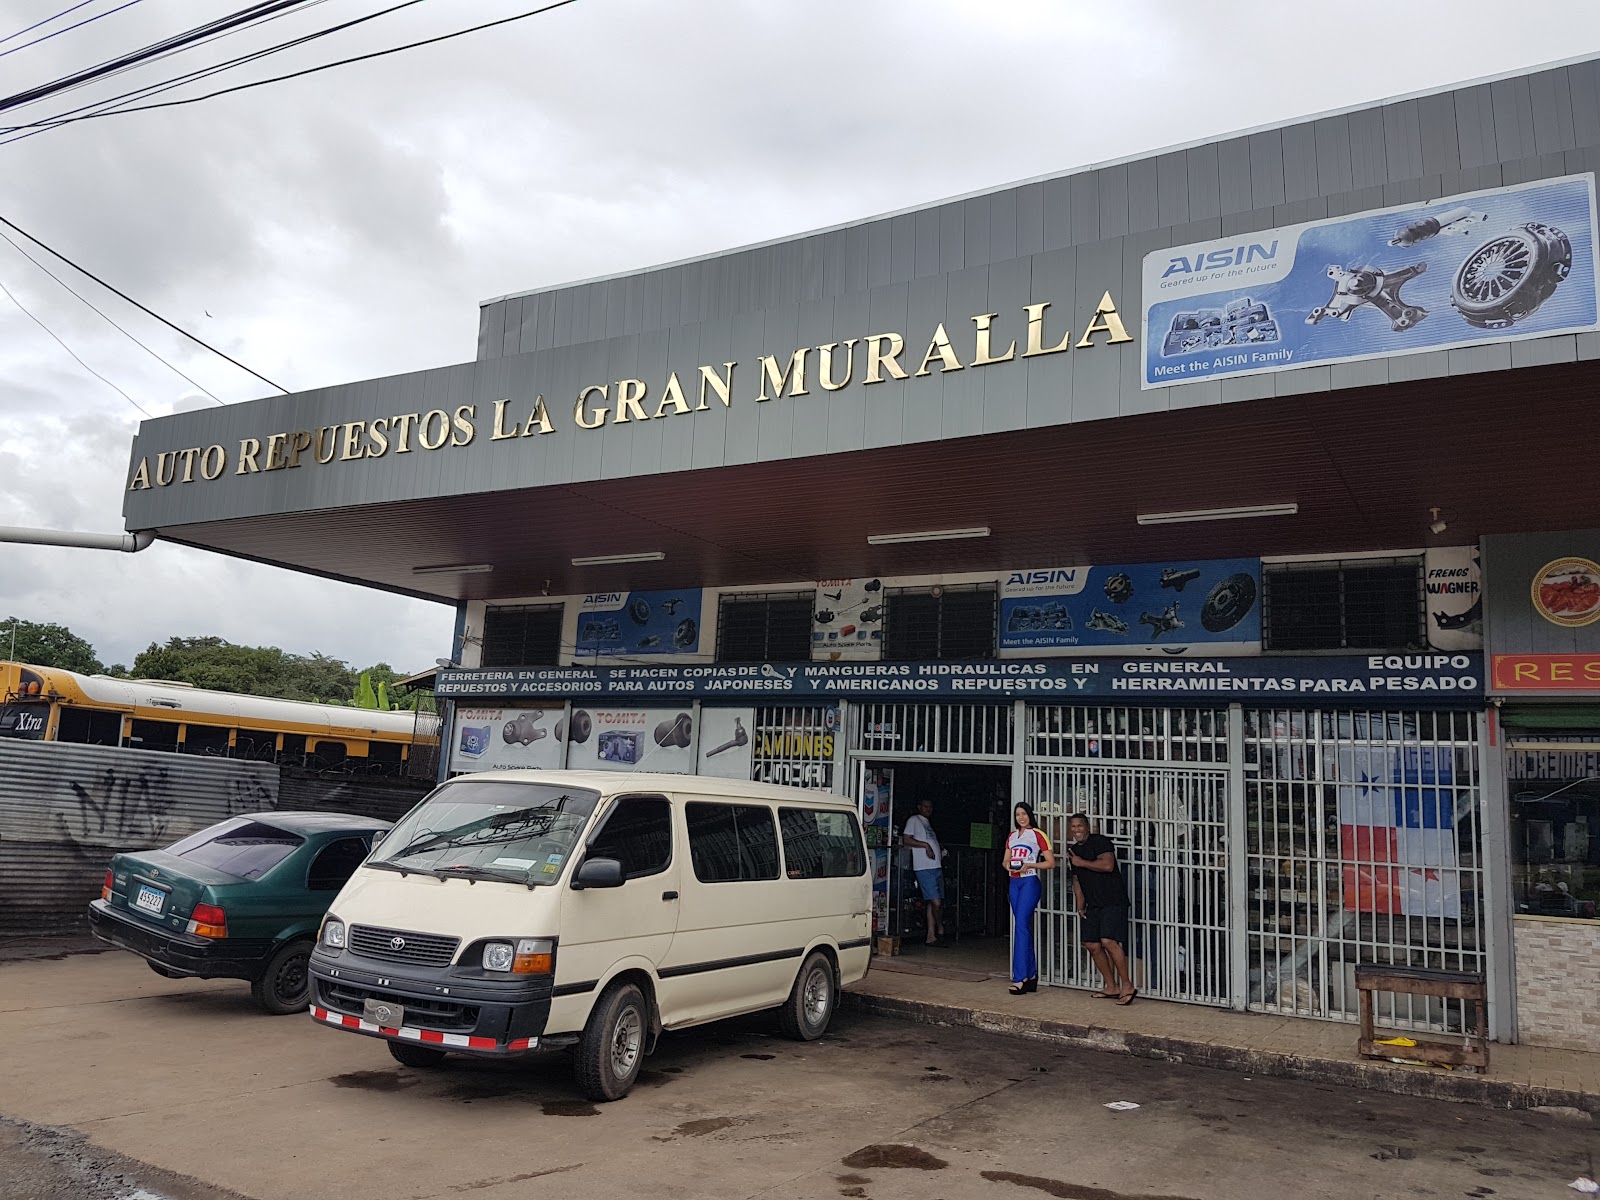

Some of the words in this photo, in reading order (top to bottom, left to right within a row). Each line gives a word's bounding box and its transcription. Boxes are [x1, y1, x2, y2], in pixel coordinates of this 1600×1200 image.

[1161, 240, 1279, 278] AISIN
[1160, 276, 1194, 289] Geared
[1196, 274, 1208, 283] up
[1211, 272, 1225, 280] for
[1228, 268, 1243, 277] the
[1246, 263, 1277, 274] future
[1154, 363, 1186, 376] Meet
[1189, 361, 1210, 372] the
[1213, 354, 1248, 368] AISIN
[1252, 348, 1294, 363] Family
[128, 445, 226, 491] AUTO
[235, 405, 476, 475] REPUESTOS
[489, 394, 556, 441] LA
[574, 361, 737, 430] GRAN
[755, 290, 1134, 403] MURALLA
[1006, 569, 1076, 585] AISIN
[1428, 567, 1469, 578] FRENOS
[816, 579, 852, 587] TOMITA
[1426, 582, 1478, 594] WAGNER
[584, 593, 621, 604] AISIN
[1056, 636, 1079, 644] Family
[441, 672, 514, 681] FERRETERIA
[518, 671, 535, 680] EN
[538, 670, 597, 679] GENERAL
[609, 669, 626, 678] SE
[630, 668, 678, 678] HACEN
[683, 667, 736, 677] COPIAS
[739, 667, 758, 676] DE
[787, 667, 797, 677] Y
[805, 665, 910, 676] MANGUERAS
[919, 664, 1046, 675] HIDRAULICAS
[1071, 663, 1099, 674] EN
[1122, 662, 1230, 673] GENERAL
[1368, 655, 1470, 670] EQUIPO
[437, 683, 507, 692] REPUESTOS
[510, 682, 520, 692] Y
[520, 681, 602, 691] ACCESORIOS
[608, 681, 644, 691] PARA
[647, 680, 695, 691] AUTOS
[704, 679, 793, 690] JAPONESES
[810, 679, 821, 690] Y
[825, 679, 939, 690] AMERICANOS
[952, 678, 1067, 690] REPUESTOS
[1073, 678, 1088, 690] Y
[1112, 677, 1296, 691] HERRAMIENTAS
[1300, 678, 1366, 692] PARA
[1370, 676, 1478, 690] PESADO
[15, 712, 43, 731] Xtra
[459, 710, 503, 720] TOMITA
[597, 713, 647, 724] TOMITA
[755, 735, 833, 757] CAMIONES
[1011, 846, 1028, 859] TH
[139, 891, 162, 907] 455227
